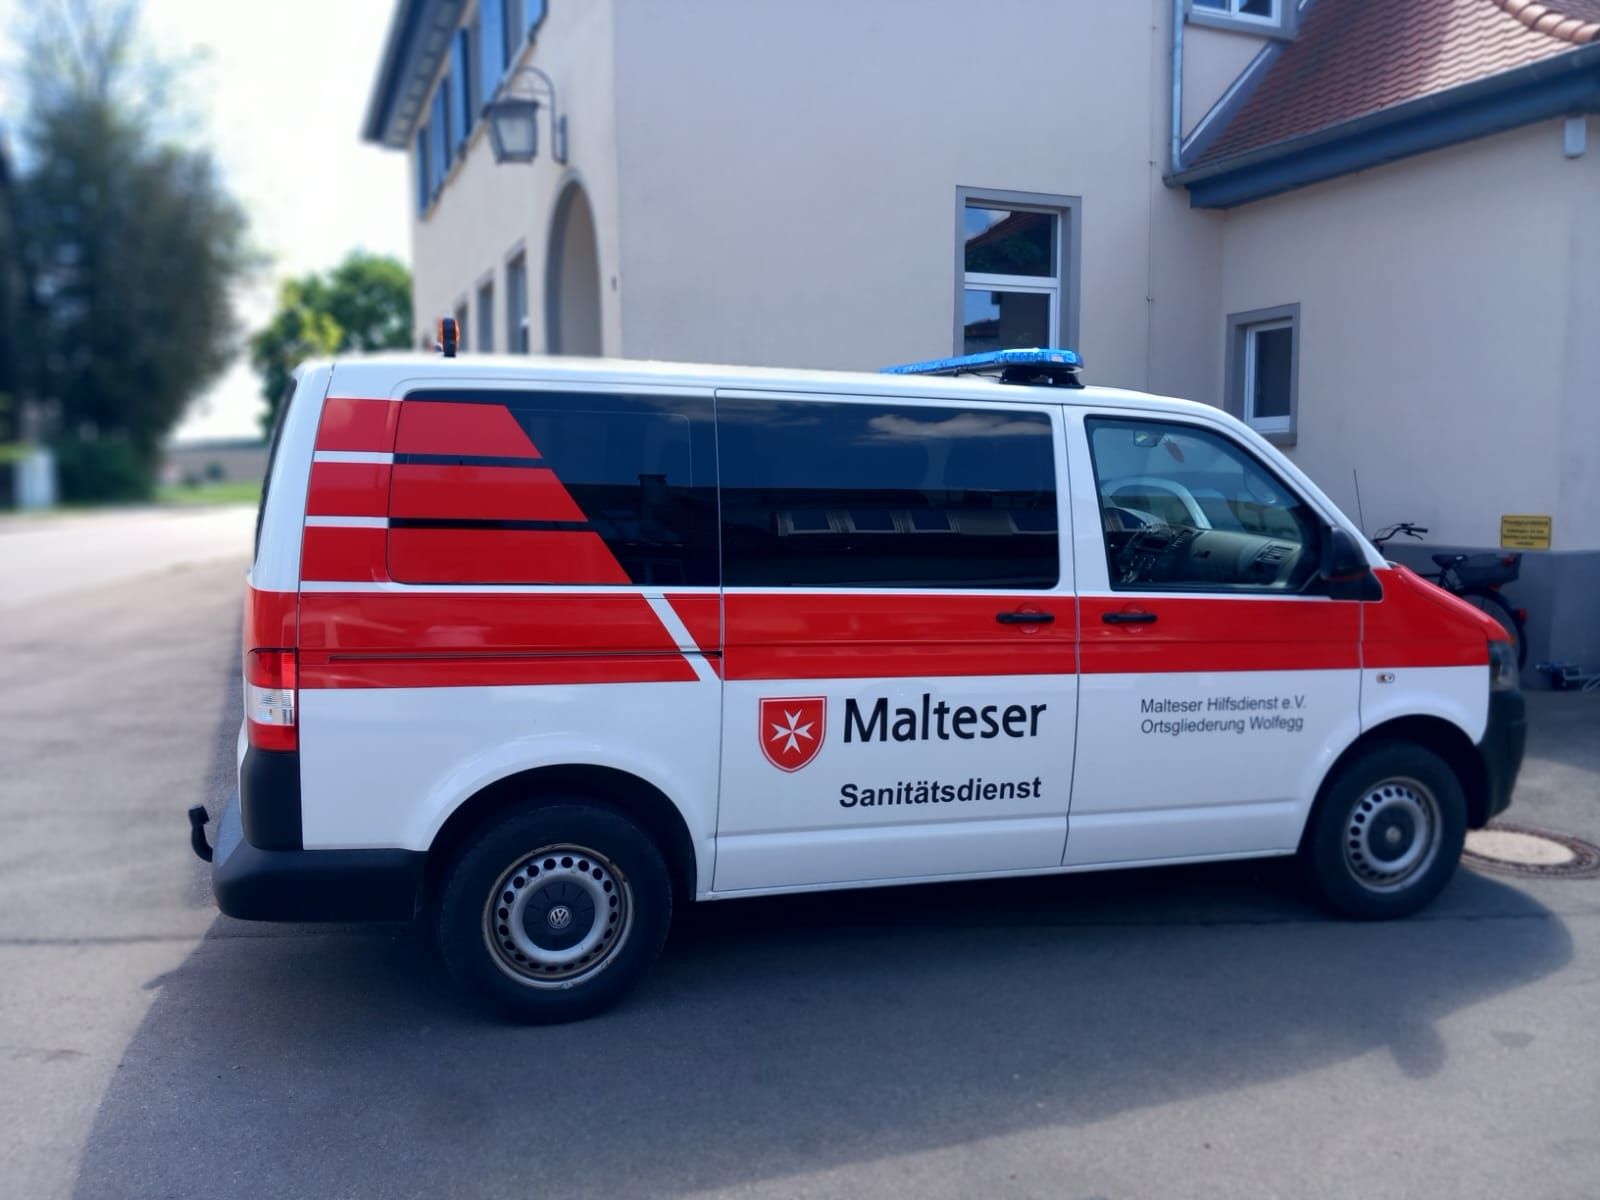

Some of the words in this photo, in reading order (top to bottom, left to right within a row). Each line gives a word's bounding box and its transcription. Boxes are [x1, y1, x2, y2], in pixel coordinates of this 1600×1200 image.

[1141, 698, 1203, 713] Malteser
[1207, 696, 1278, 712] Hilfsdienst
[1281, 694, 1307, 710] e.V.
[843, 693, 1047, 743] Malteser
[1141, 718, 1246, 737] Ortsgliederung
[1249, 715, 1304, 733] Wolfegg
[839, 776, 1042, 808] Sanitätsdienst
